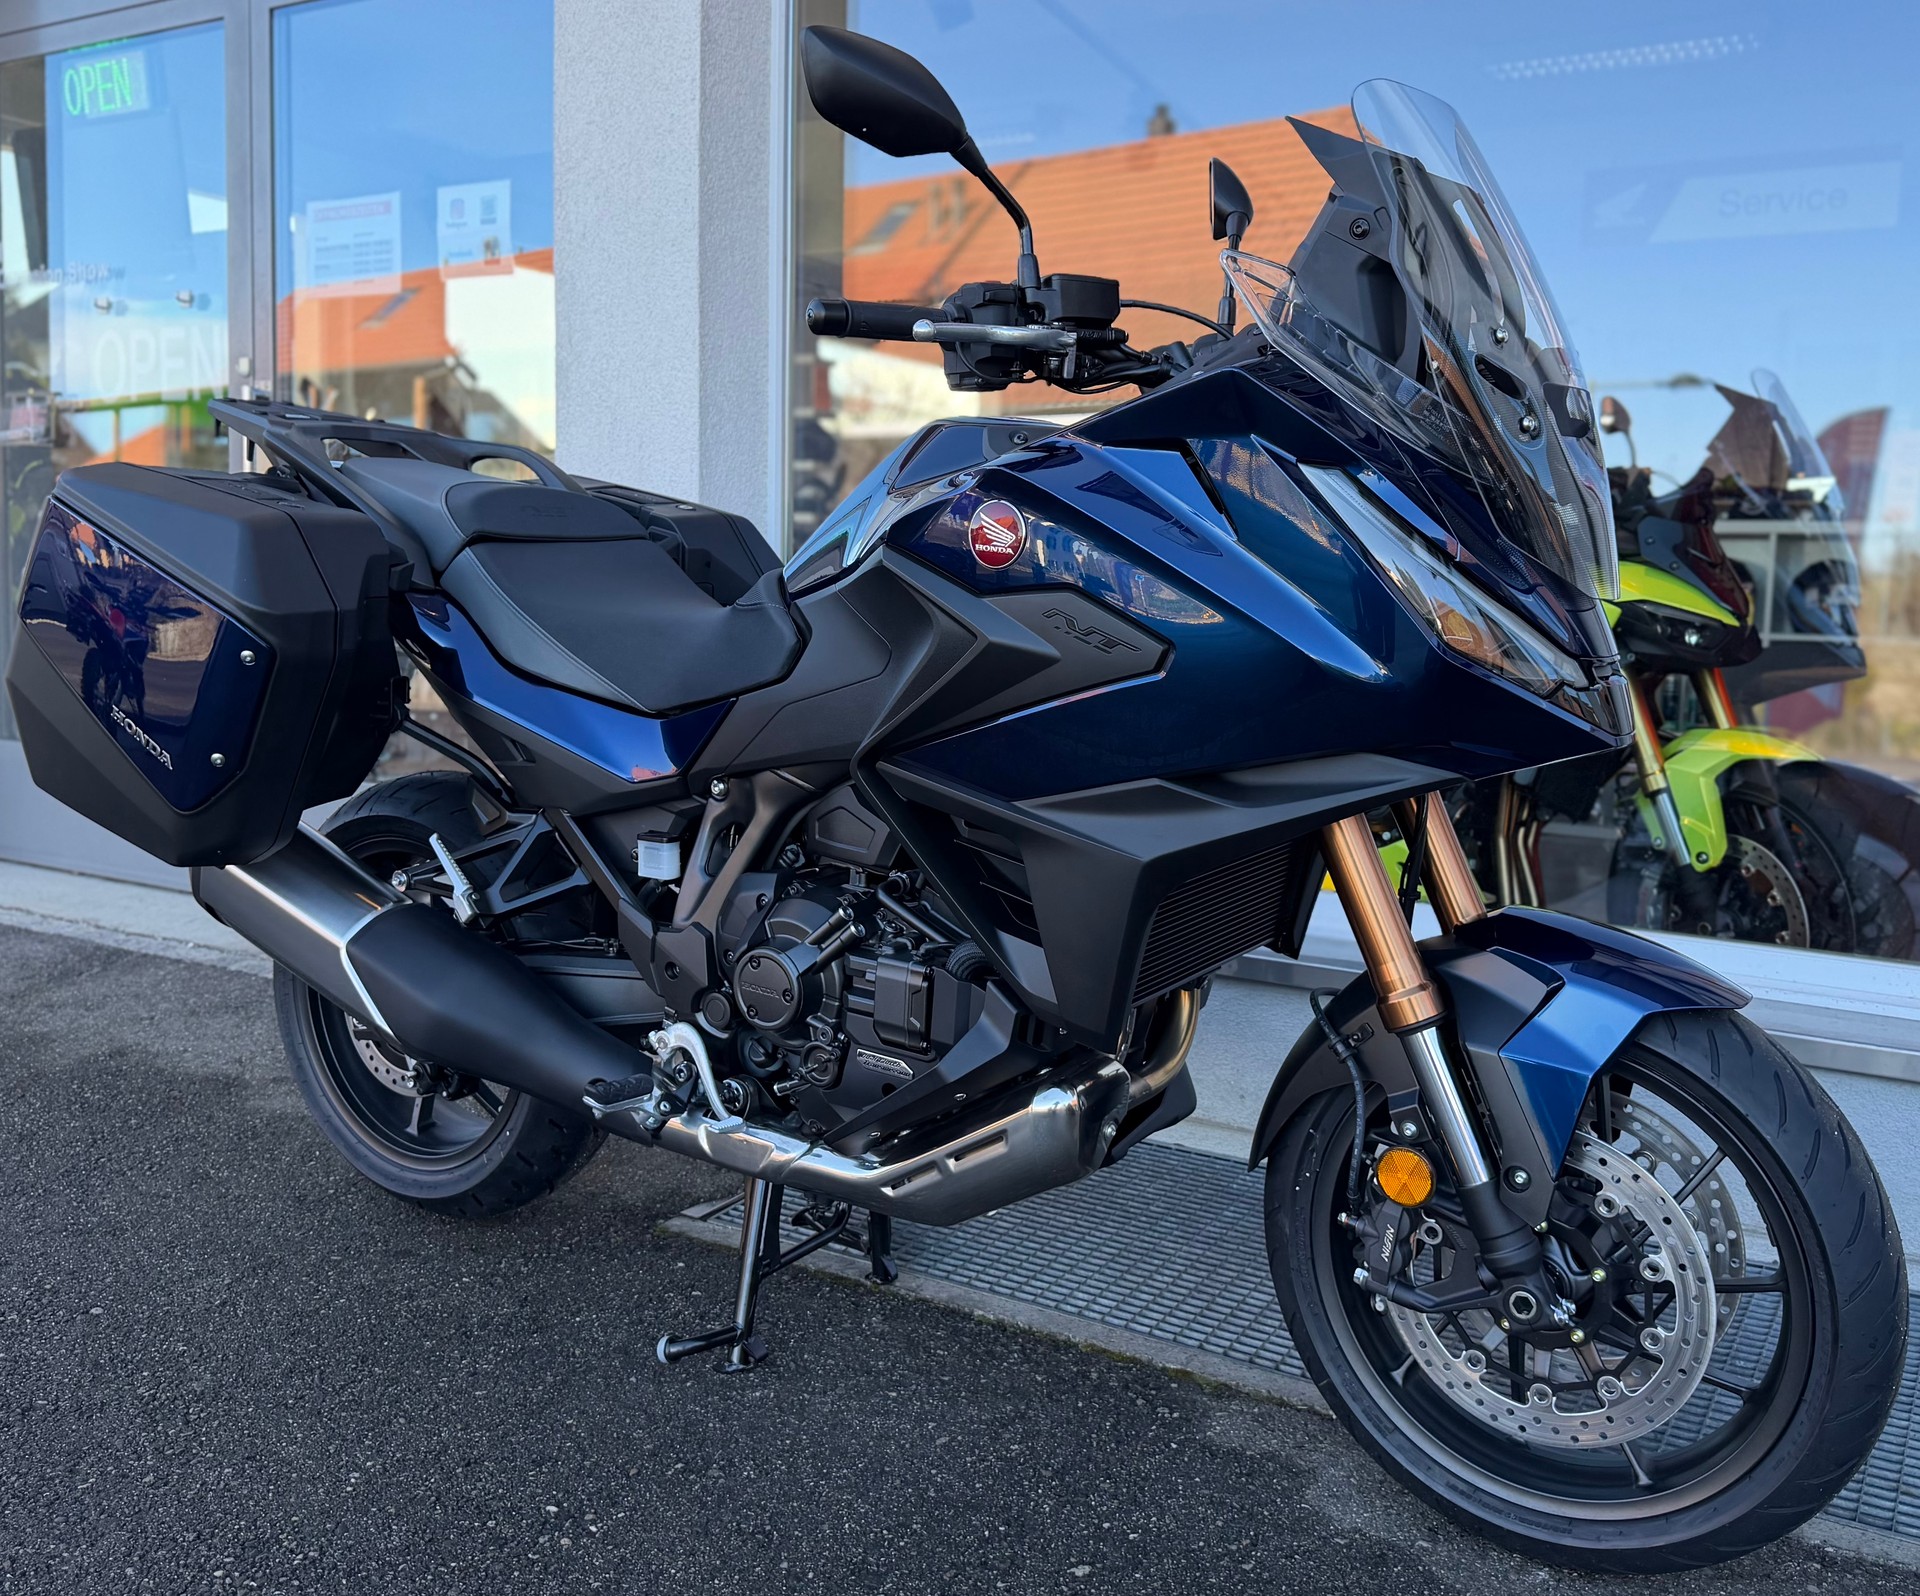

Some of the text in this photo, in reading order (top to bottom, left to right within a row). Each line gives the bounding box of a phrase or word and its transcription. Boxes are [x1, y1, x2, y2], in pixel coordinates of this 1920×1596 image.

[64, 57, 132, 116] OPEN
[1717, 186, 1848, 219] Service
[94, 325, 227, 402] OPEN
[974, 543, 1015, 555] HONDA
[110, 704, 173, 770] HONDA
[741, 981, 780, 999] HONDA
